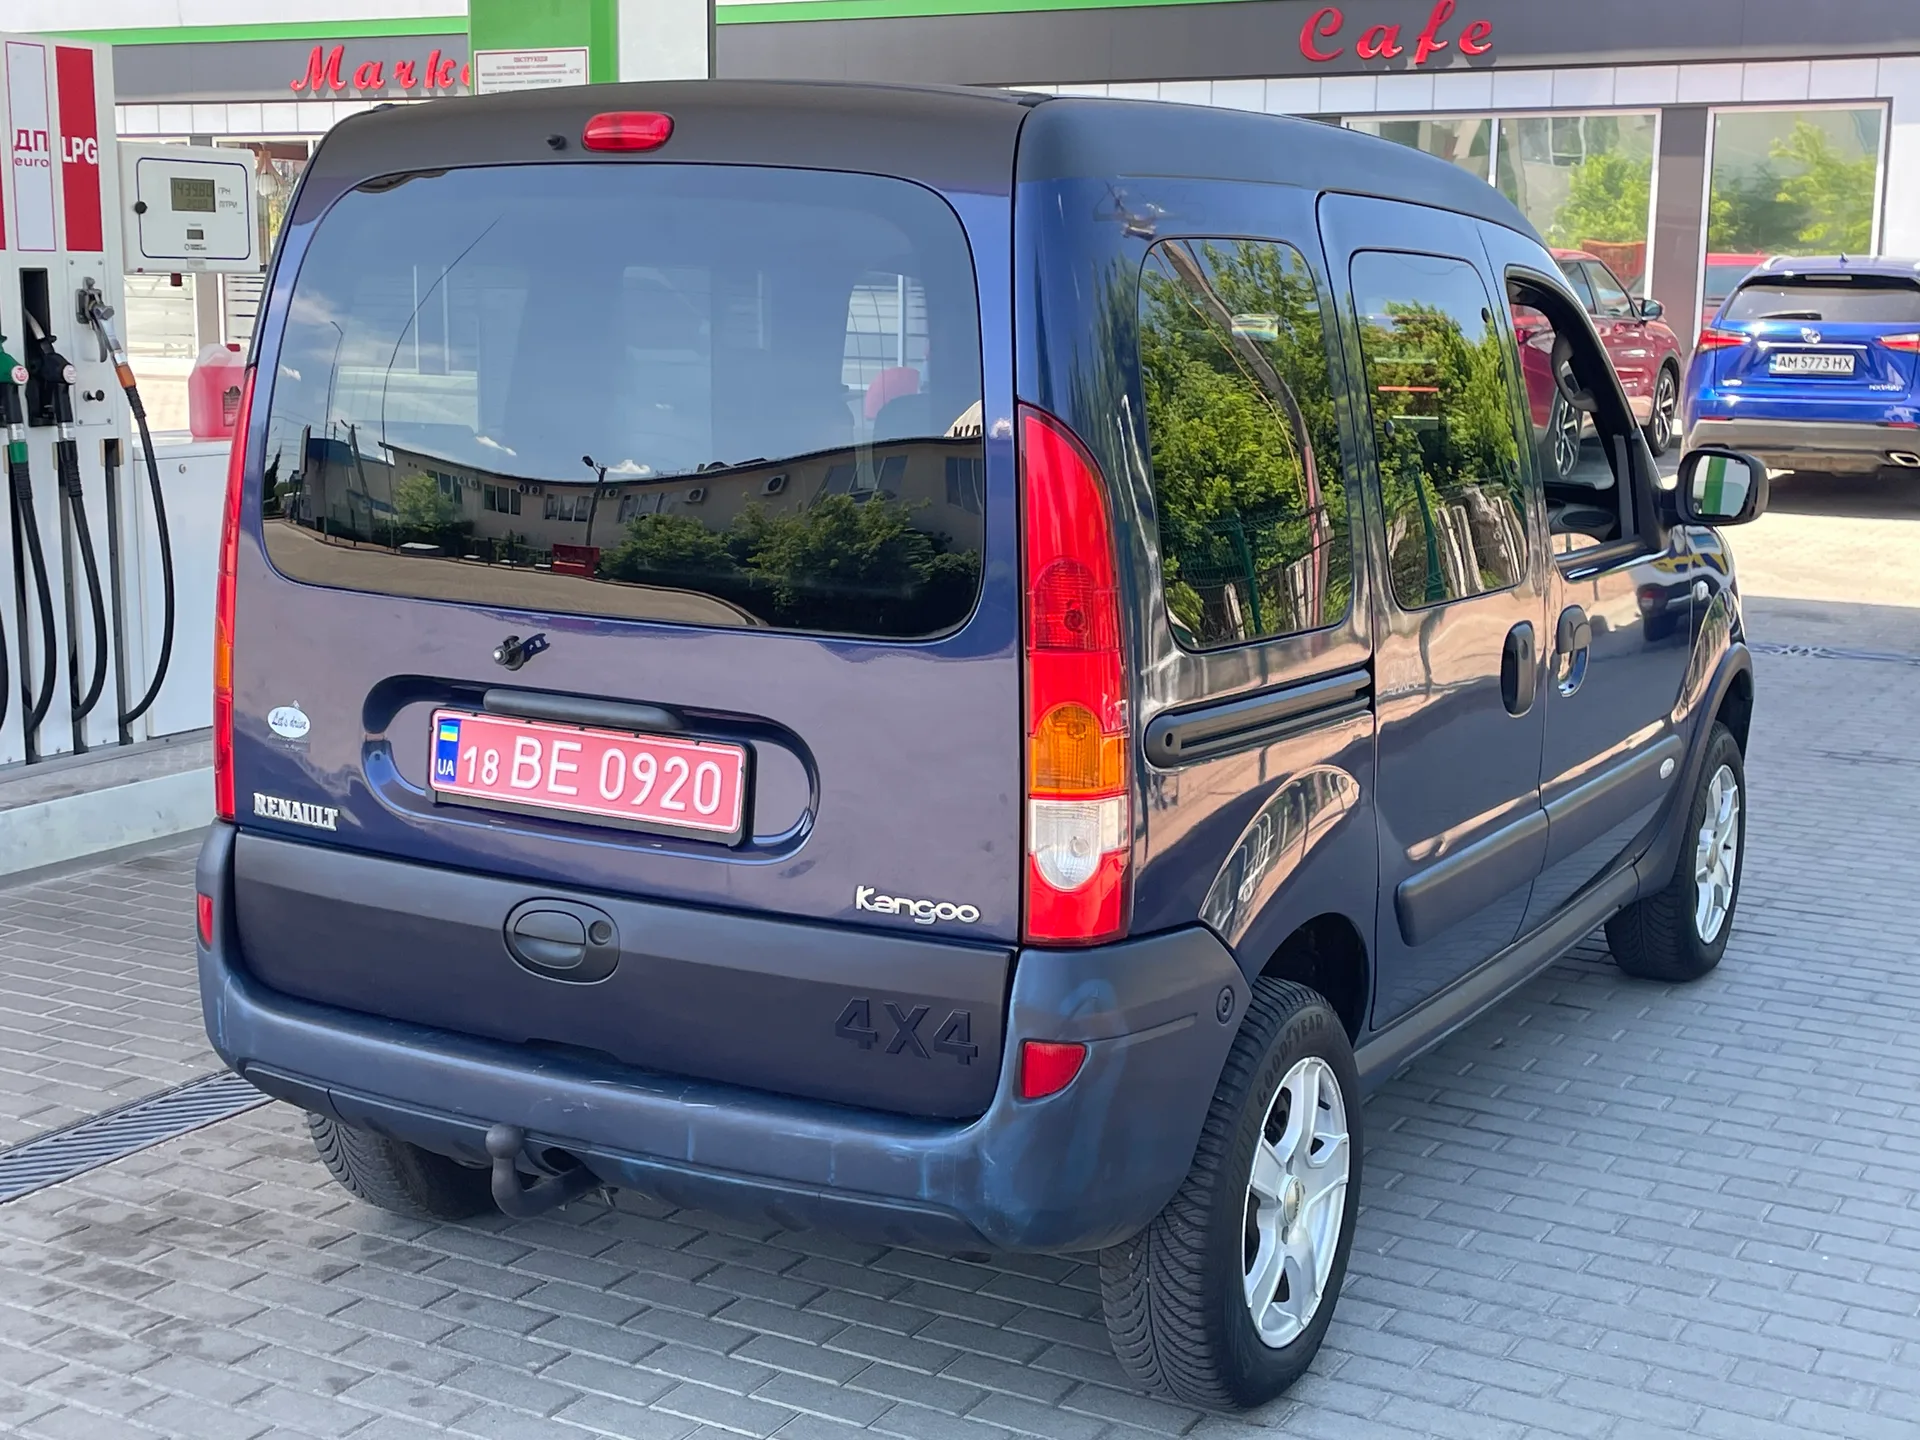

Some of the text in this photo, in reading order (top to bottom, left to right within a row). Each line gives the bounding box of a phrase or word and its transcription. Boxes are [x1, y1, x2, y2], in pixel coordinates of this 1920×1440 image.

[1300, 0, 1493, 64] Cafe
[14, 129, 48, 152] ДП
[61, 136, 98, 164] LPG
[14, 157, 50, 167] euro
[1778, 356, 1853, 371] AM 5773 HX
[437, 758, 455, 777] UA
[462, 735, 723, 816] 18 BE 0920
[253, 792, 339, 831] RENAULT
[855, 885, 981, 925] Kangoo
